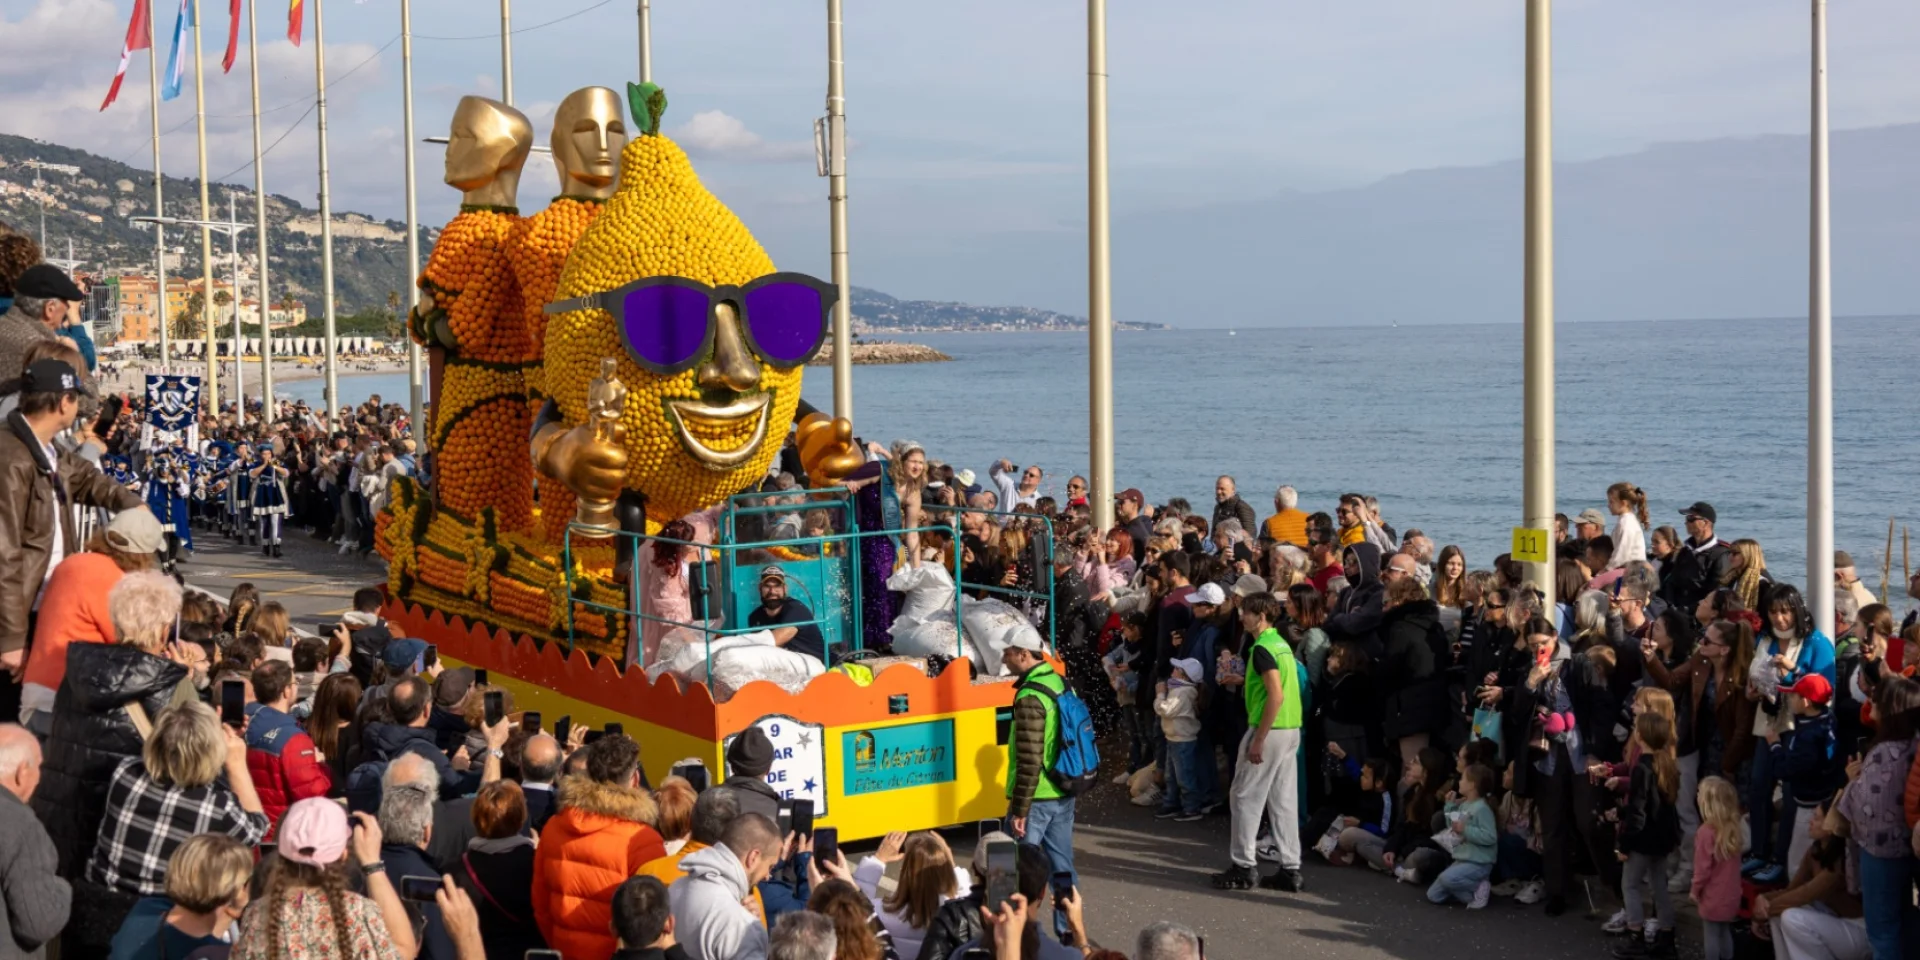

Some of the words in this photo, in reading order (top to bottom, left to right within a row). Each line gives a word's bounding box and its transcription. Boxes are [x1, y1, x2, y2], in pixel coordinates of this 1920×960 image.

[1519, 535, 1538, 553] 11
[770, 724, 780, 737] 9
[774, 747, 793, 760] AR
[880, 745, 945, 769] Menton
[767, 770, 787, 783] DE
